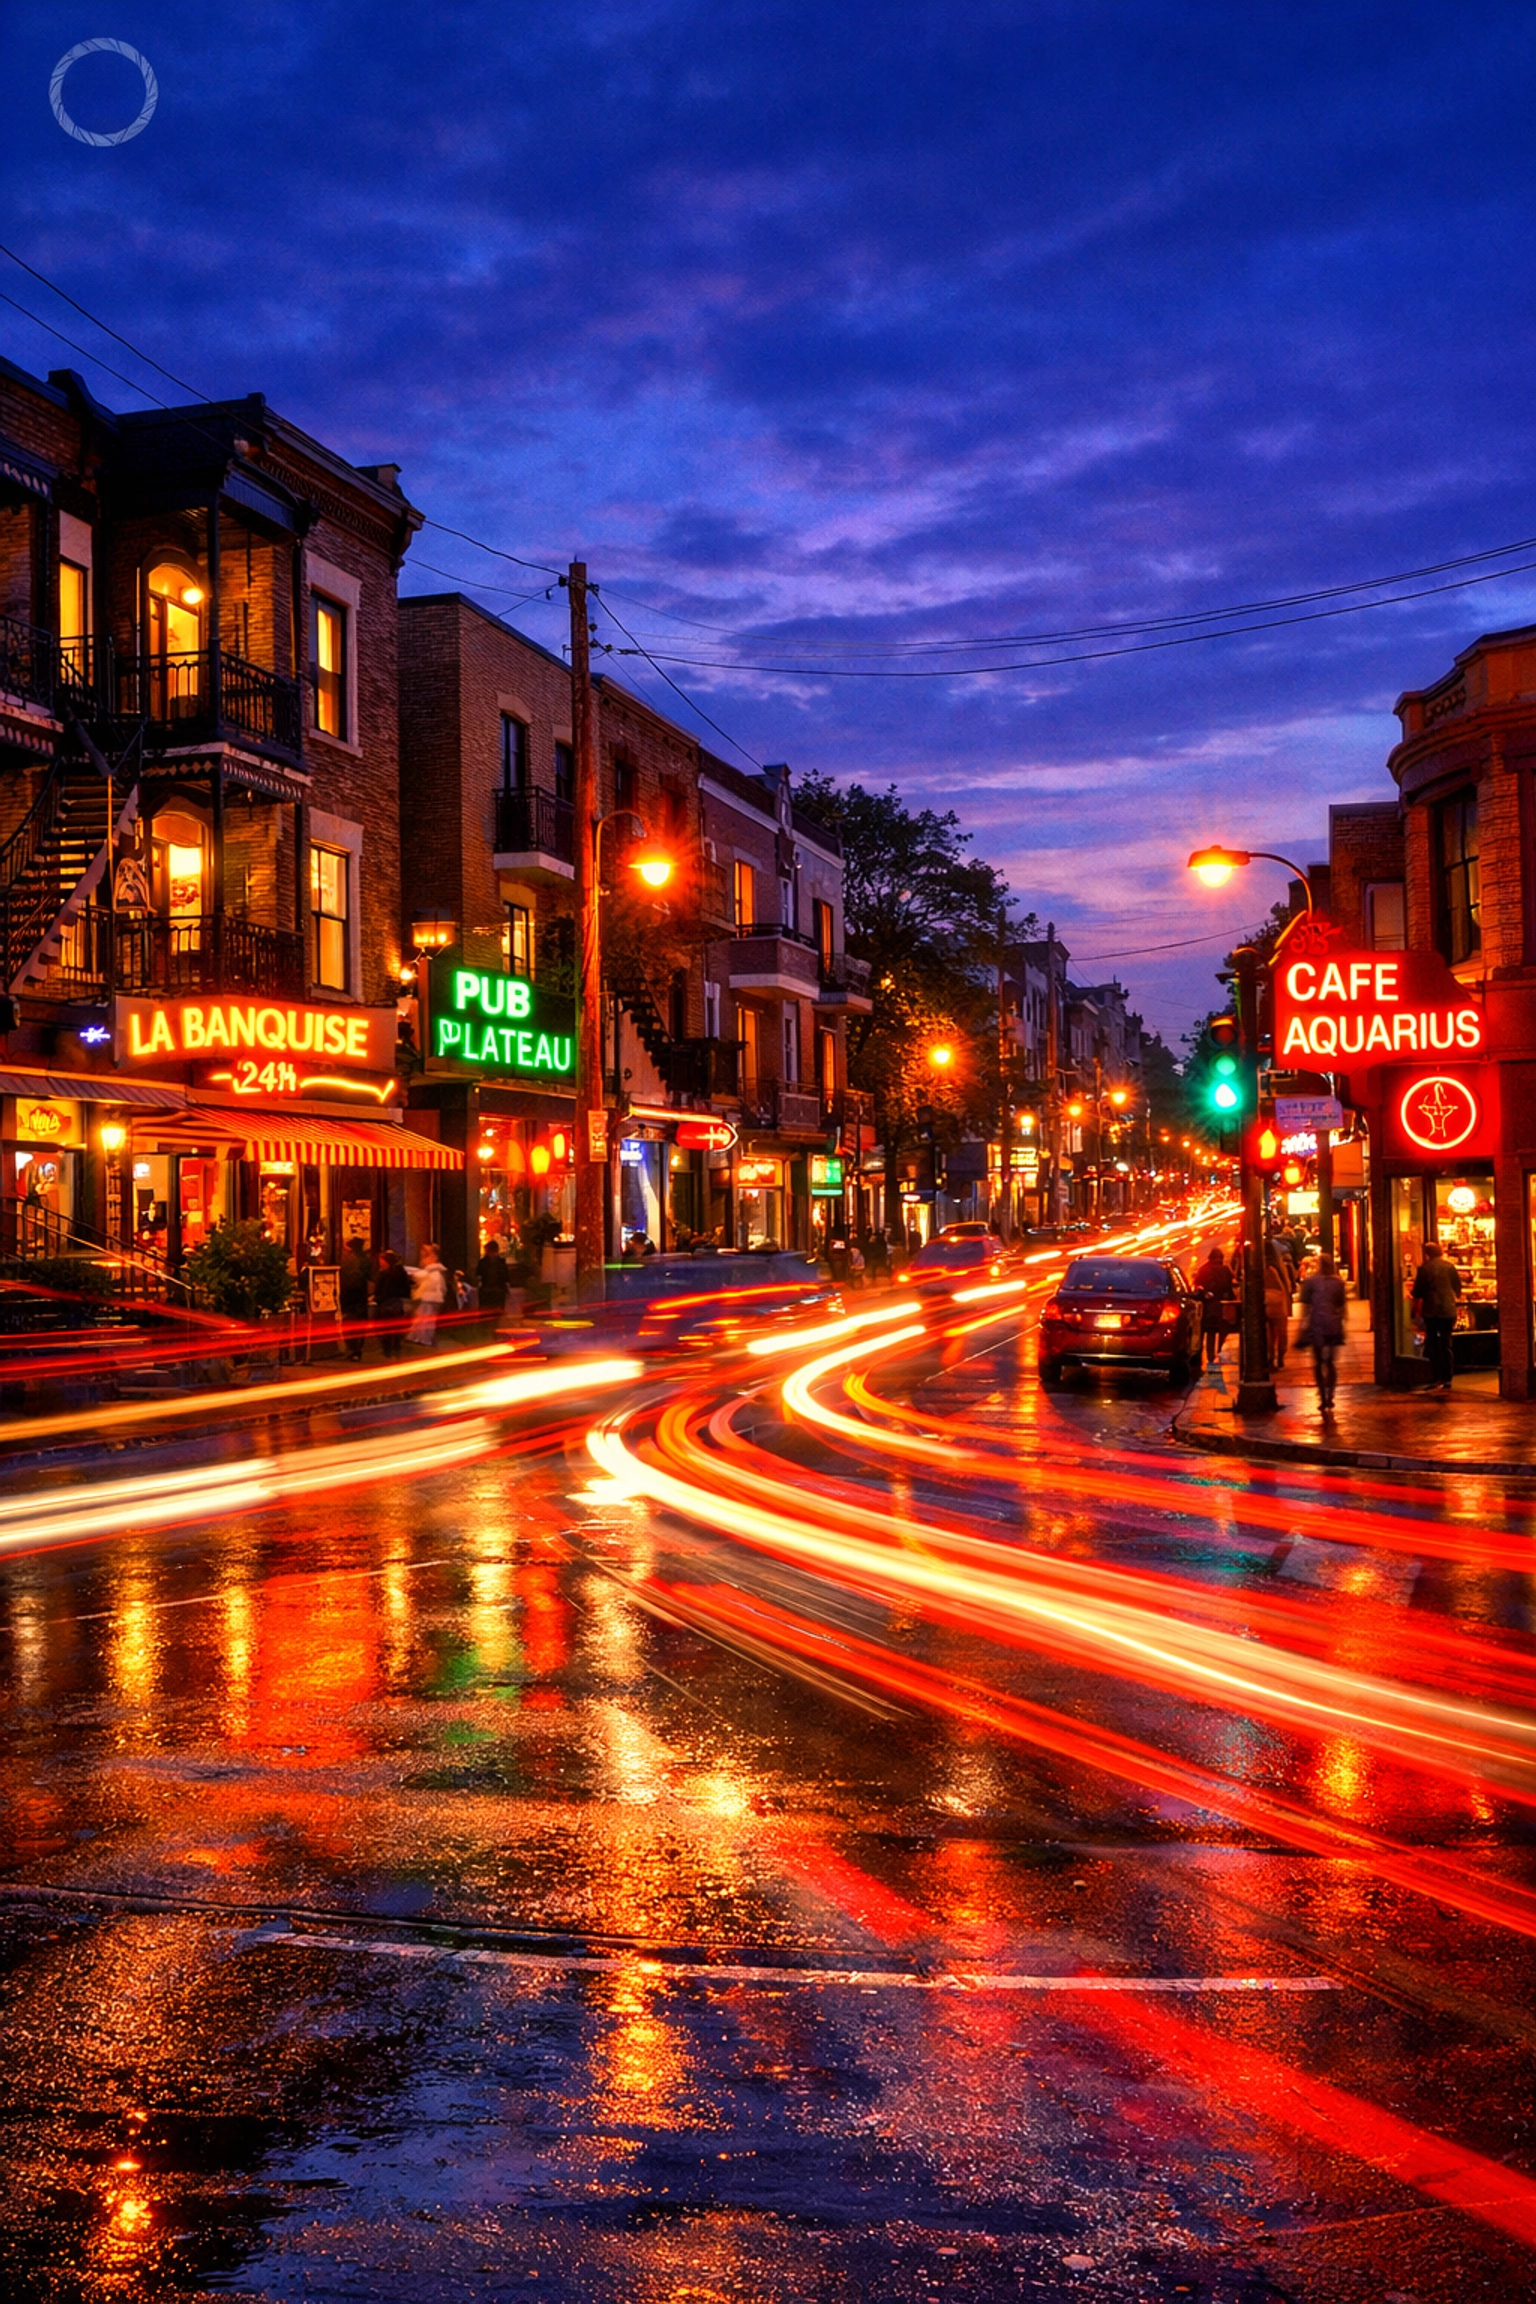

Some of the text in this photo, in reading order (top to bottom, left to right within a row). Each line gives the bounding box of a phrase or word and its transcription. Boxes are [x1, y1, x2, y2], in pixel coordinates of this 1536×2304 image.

[456, 970, 530, 1018] PUB
[1286, 962, 1399, 1001] CAFE
[131, 1006, 369, 1057] LA BANQUISE
[438, 1018, 571, 1072] PLATEAU
[1282, 1010, 1480, 1057] AQUARIUS
